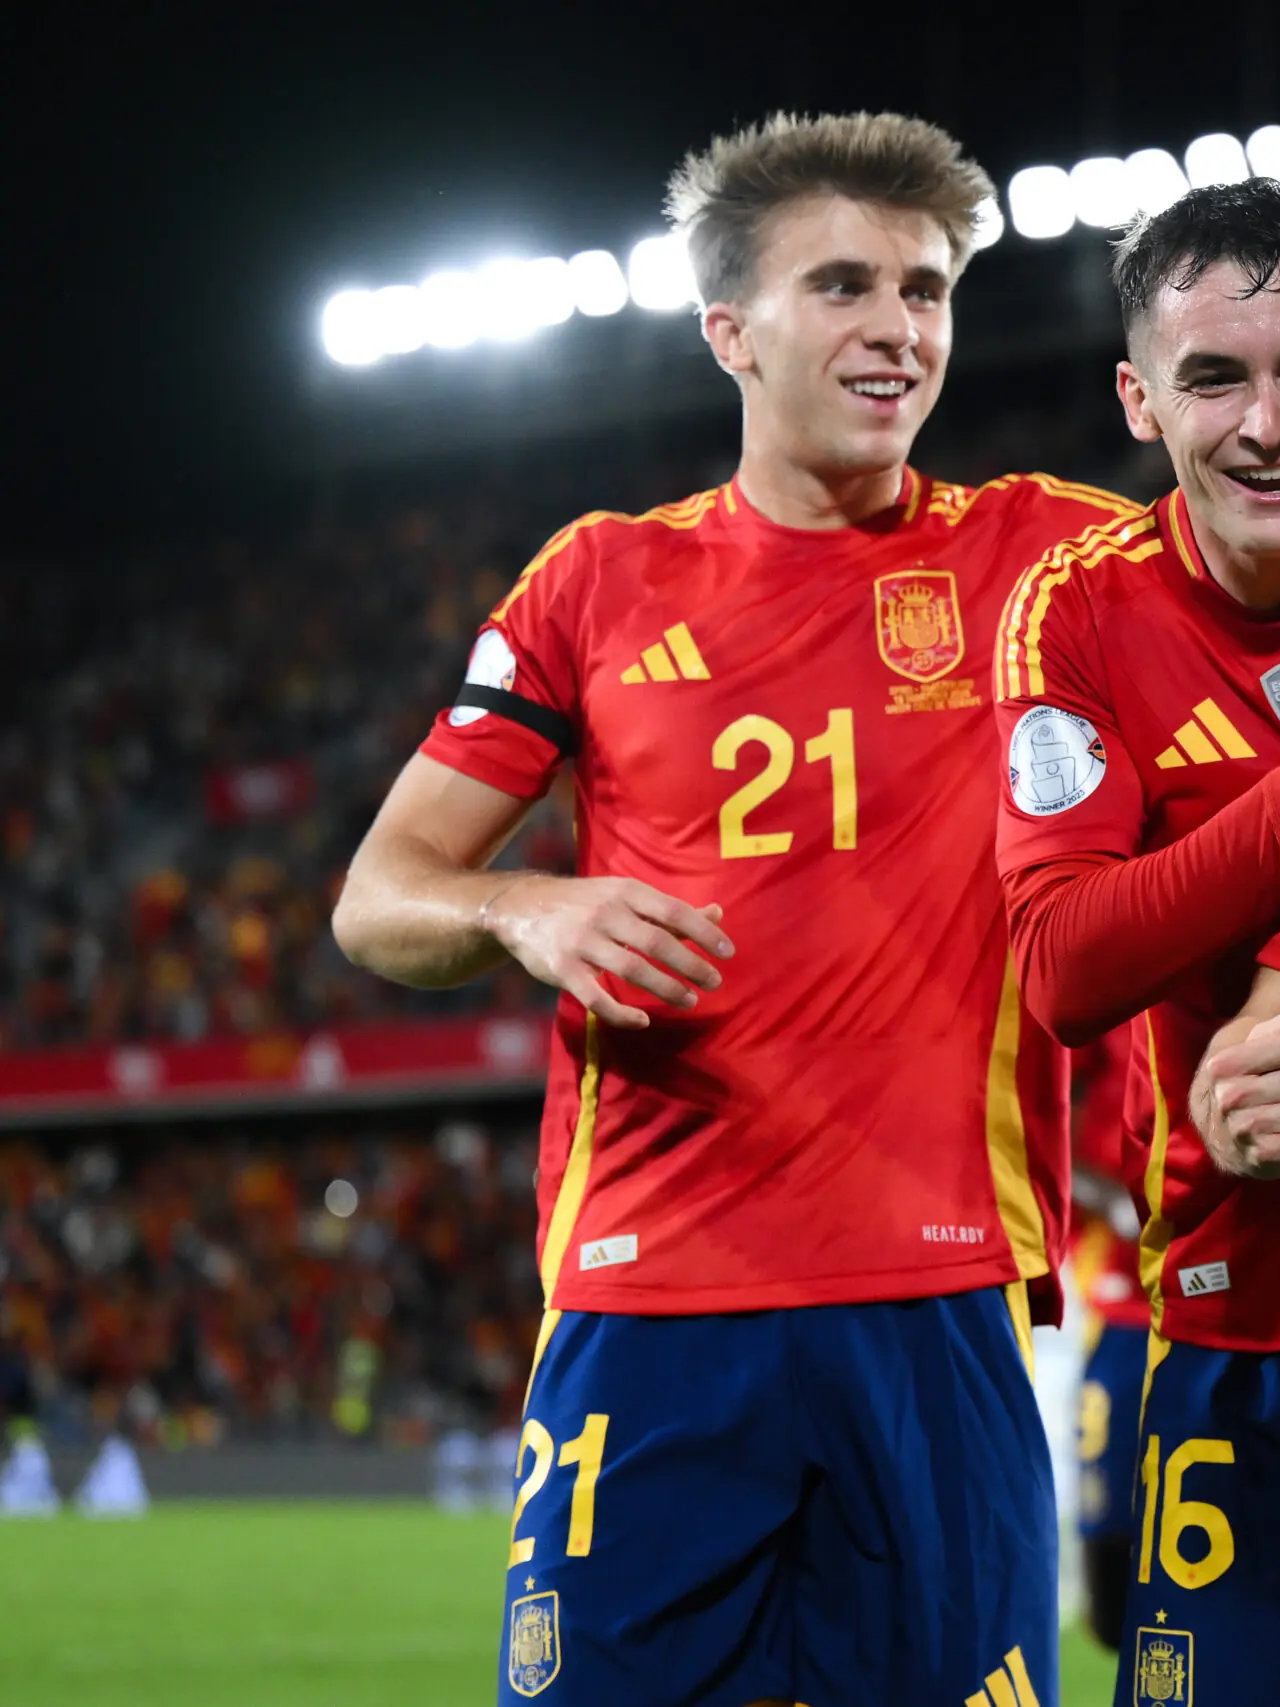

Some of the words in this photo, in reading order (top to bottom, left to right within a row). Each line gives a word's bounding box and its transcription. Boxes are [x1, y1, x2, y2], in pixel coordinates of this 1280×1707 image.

[1021, 708, 1053, 729] NATIONS
[711, 708, 857, 859] 21
[1035, 801, 1066, 812] WINNER
[1067, 789, 1085, 804] 2023
[922, 1224, 985, 1244] HEAT.RDY
[507, 1413, 610, 1570] 21
[1137, 1434, 1236, 1590] 16
